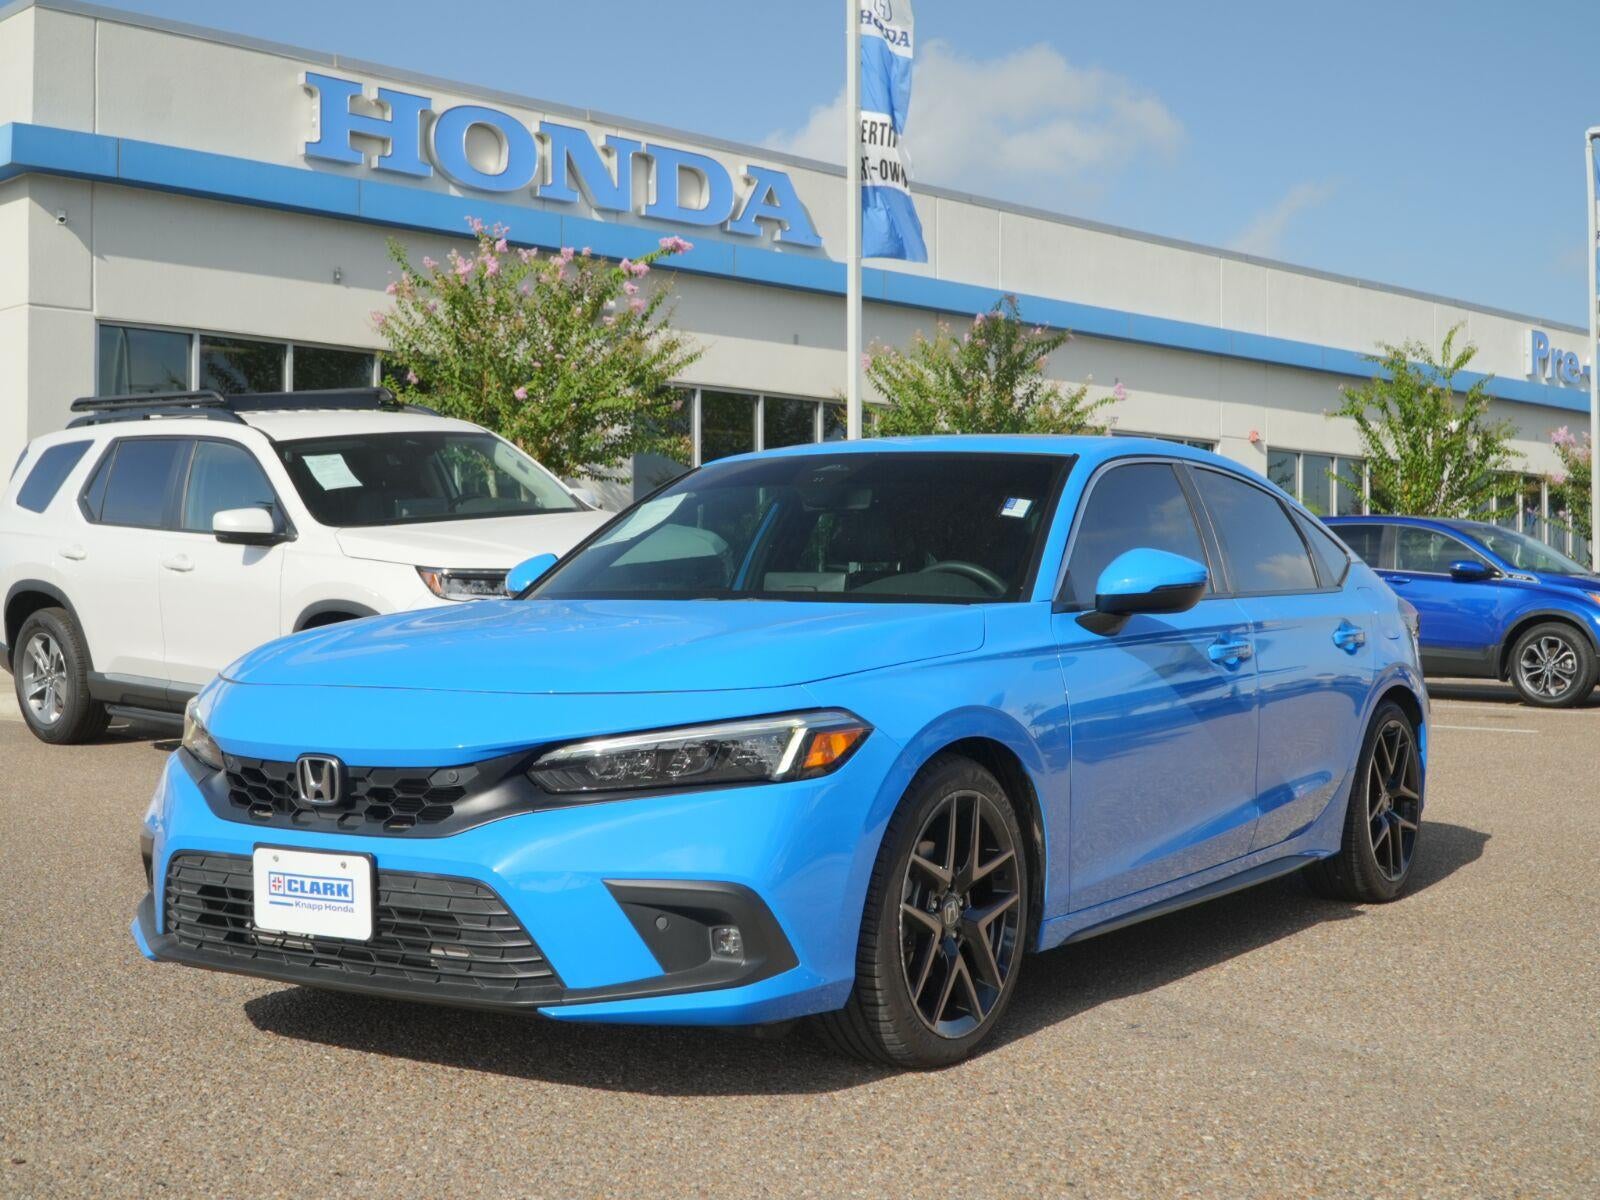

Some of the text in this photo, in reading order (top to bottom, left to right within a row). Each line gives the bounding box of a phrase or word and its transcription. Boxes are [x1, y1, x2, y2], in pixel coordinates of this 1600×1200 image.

[303, 71, 823, 247] HONDA
[287, 878, 350, 898] CLARK
[295, 900, 354, 913] Knapp Honda
